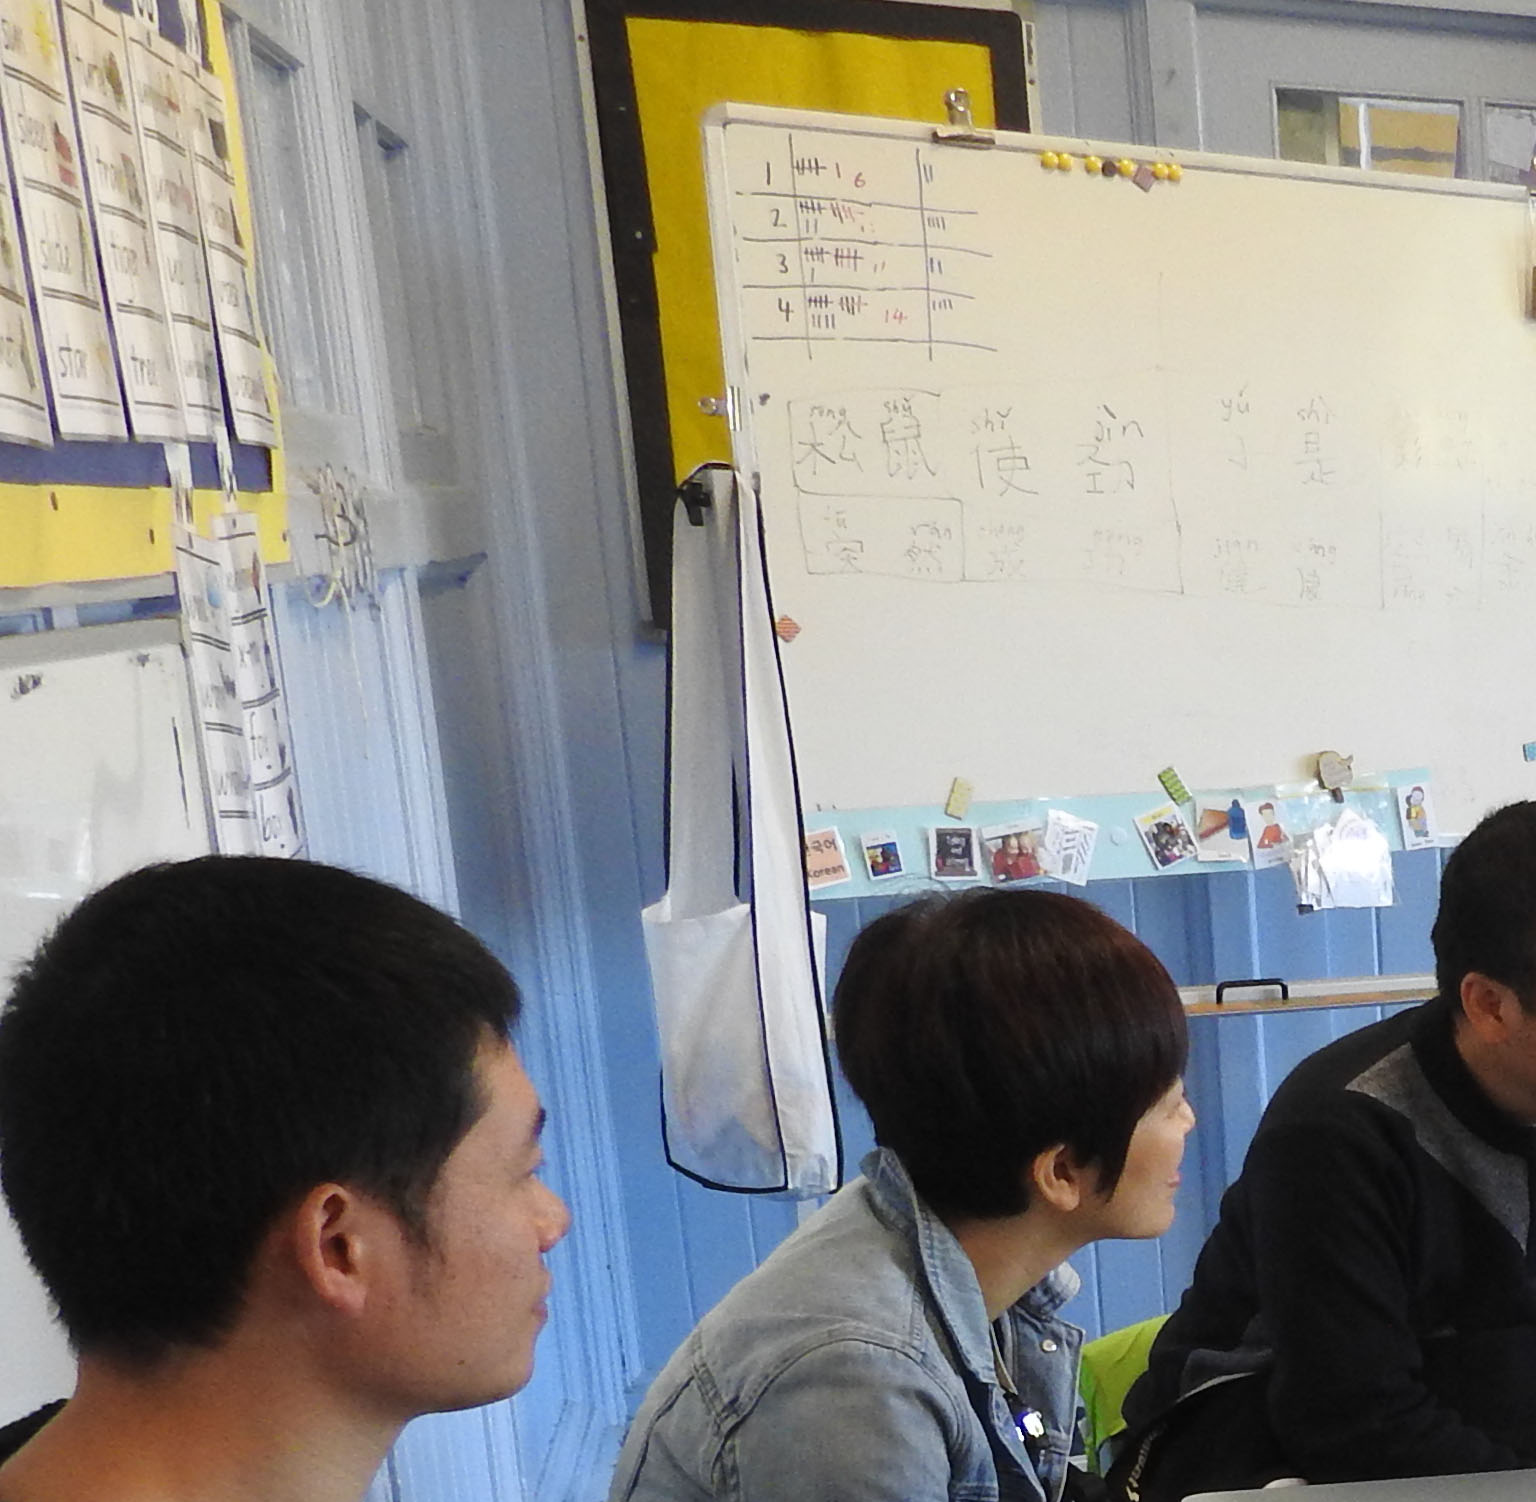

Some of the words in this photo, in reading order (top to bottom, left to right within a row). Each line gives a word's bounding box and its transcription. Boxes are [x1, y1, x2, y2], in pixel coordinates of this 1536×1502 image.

[854, 172, 866, 188] 6
[769, 208, 788, 228] 2
[776, 253, 789, 274] 3
[778, 297, 795, 323] 4
[805, 838, 838, 856] 국어
